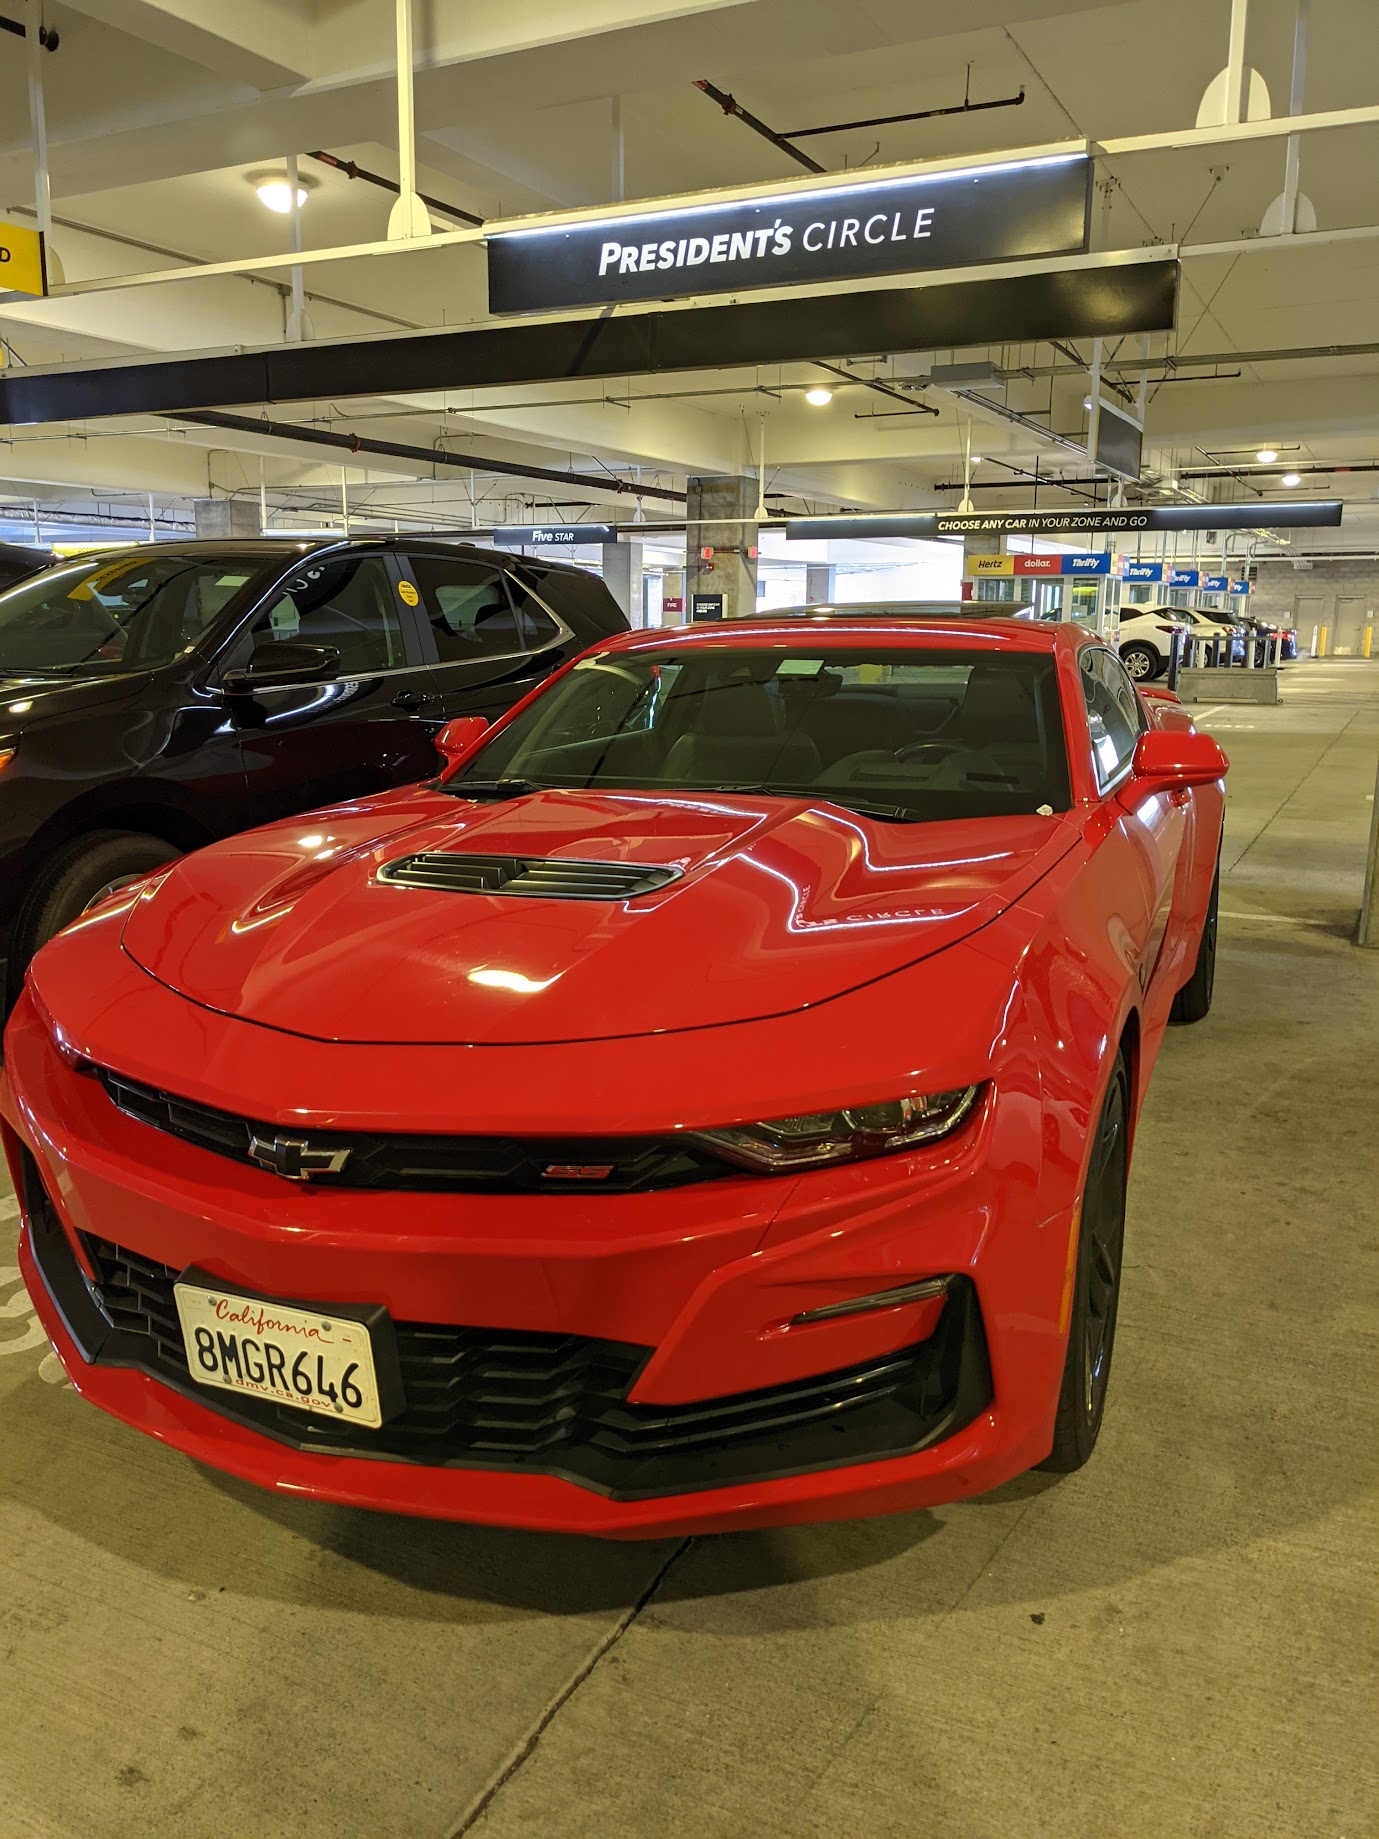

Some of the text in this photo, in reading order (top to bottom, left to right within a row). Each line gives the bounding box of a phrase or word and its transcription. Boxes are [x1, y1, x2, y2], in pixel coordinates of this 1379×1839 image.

[598, 207, 936, 277] PRESIDENT'S CIRCLE
[938, 516, 1147, 531] CHOOSE ANY CAR IN YOUR ZONE AND GO
[532, 530, 575, 542] Five STAR
[978, 560, 1003, 569] Hertz
[1072, 558, 1100, 569] Thrifty
[1129, 567, 1153, 578] Thrifty
[215, 1298, 334, 1344] California
[194, 1326, 363, 1409] 8MGR646
[235, 1377, 331, 1409] dmv.ca.gov
